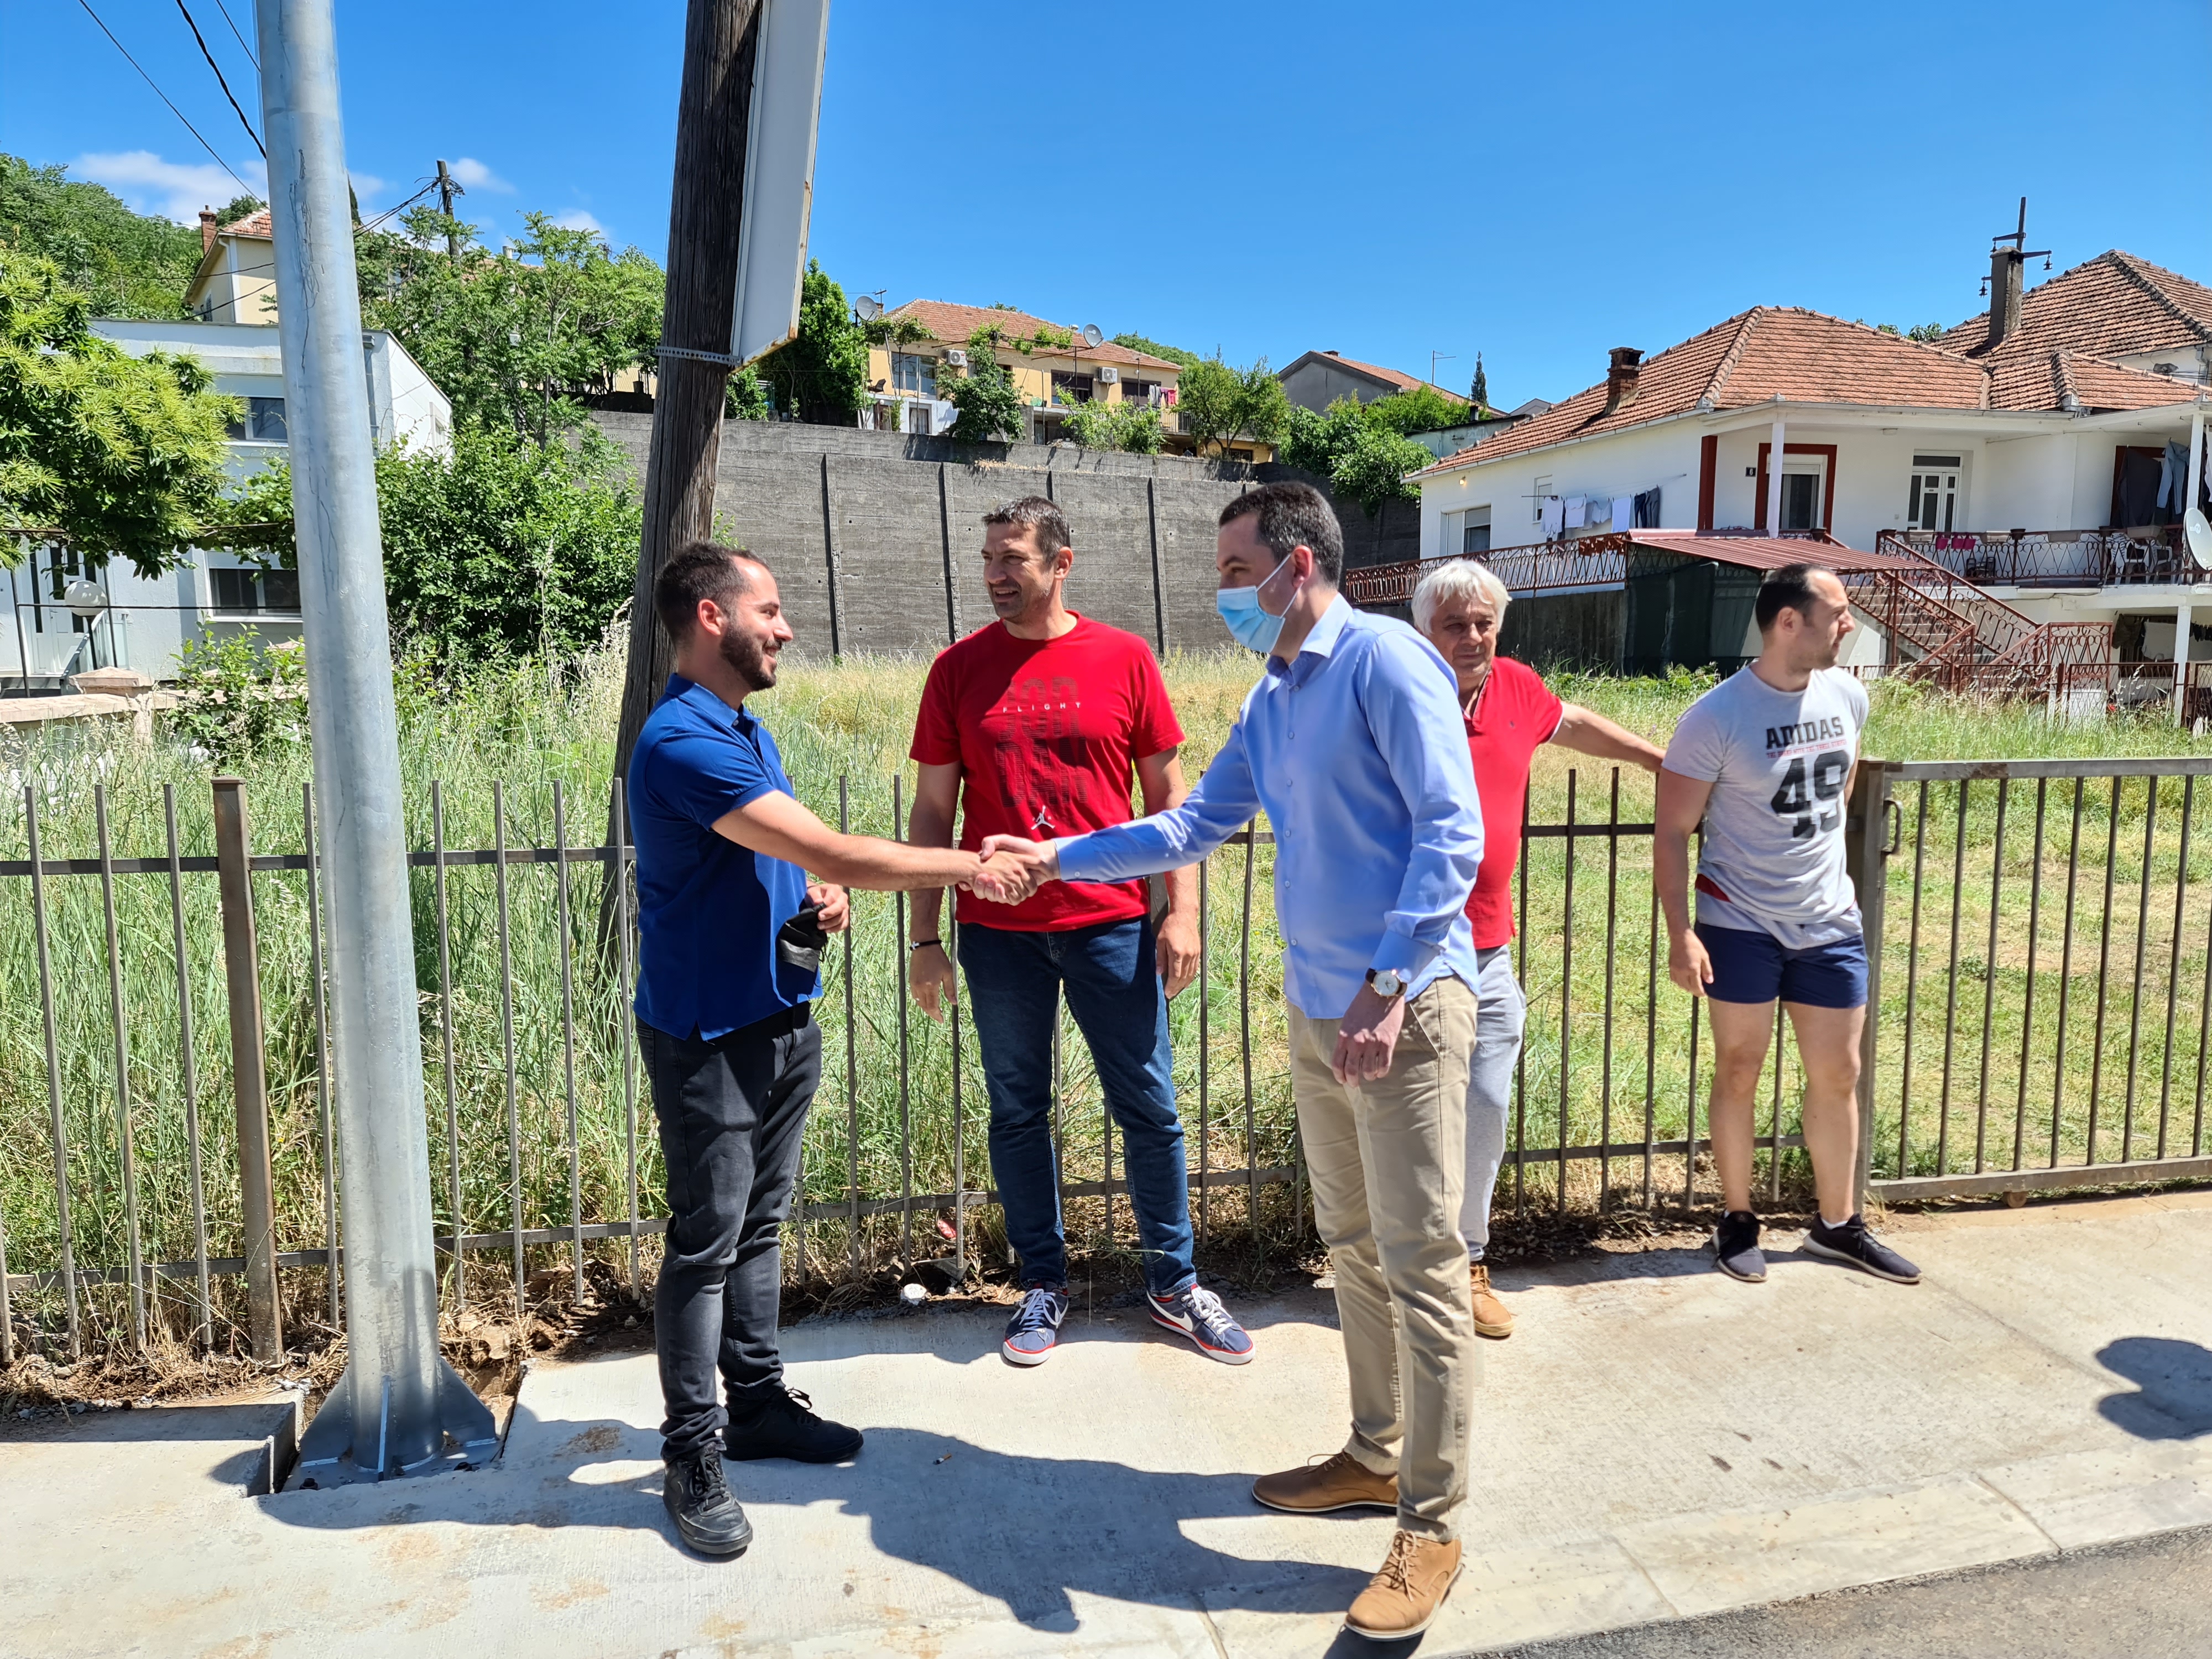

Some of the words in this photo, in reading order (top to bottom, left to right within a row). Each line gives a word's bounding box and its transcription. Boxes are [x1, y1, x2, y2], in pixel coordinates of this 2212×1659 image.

[1003, 702, 1081, 713] FLIGHT
[1766, 716, 1845, 750] ADIDAS
[1771, 750, 1850, 838] 49
